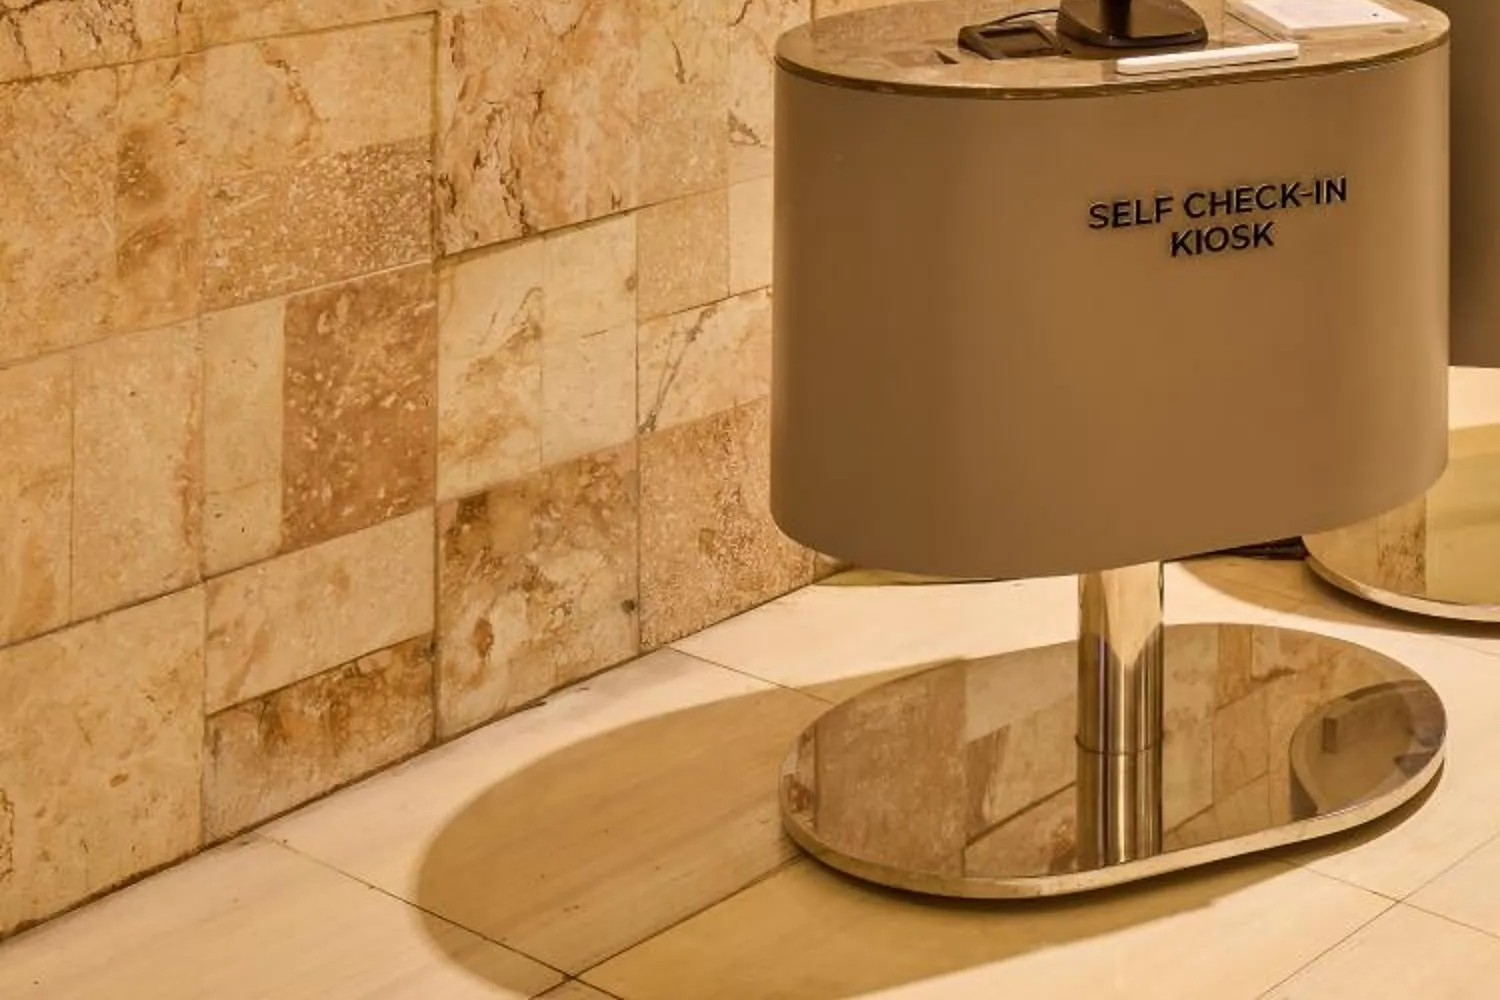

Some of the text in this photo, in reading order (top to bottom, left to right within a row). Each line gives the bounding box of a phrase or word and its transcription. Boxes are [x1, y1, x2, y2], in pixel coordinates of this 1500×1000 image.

[1088, 176, 1348, 230] SELF CHECK-IN
[1170, 220, 1275, 257] KIOSK
